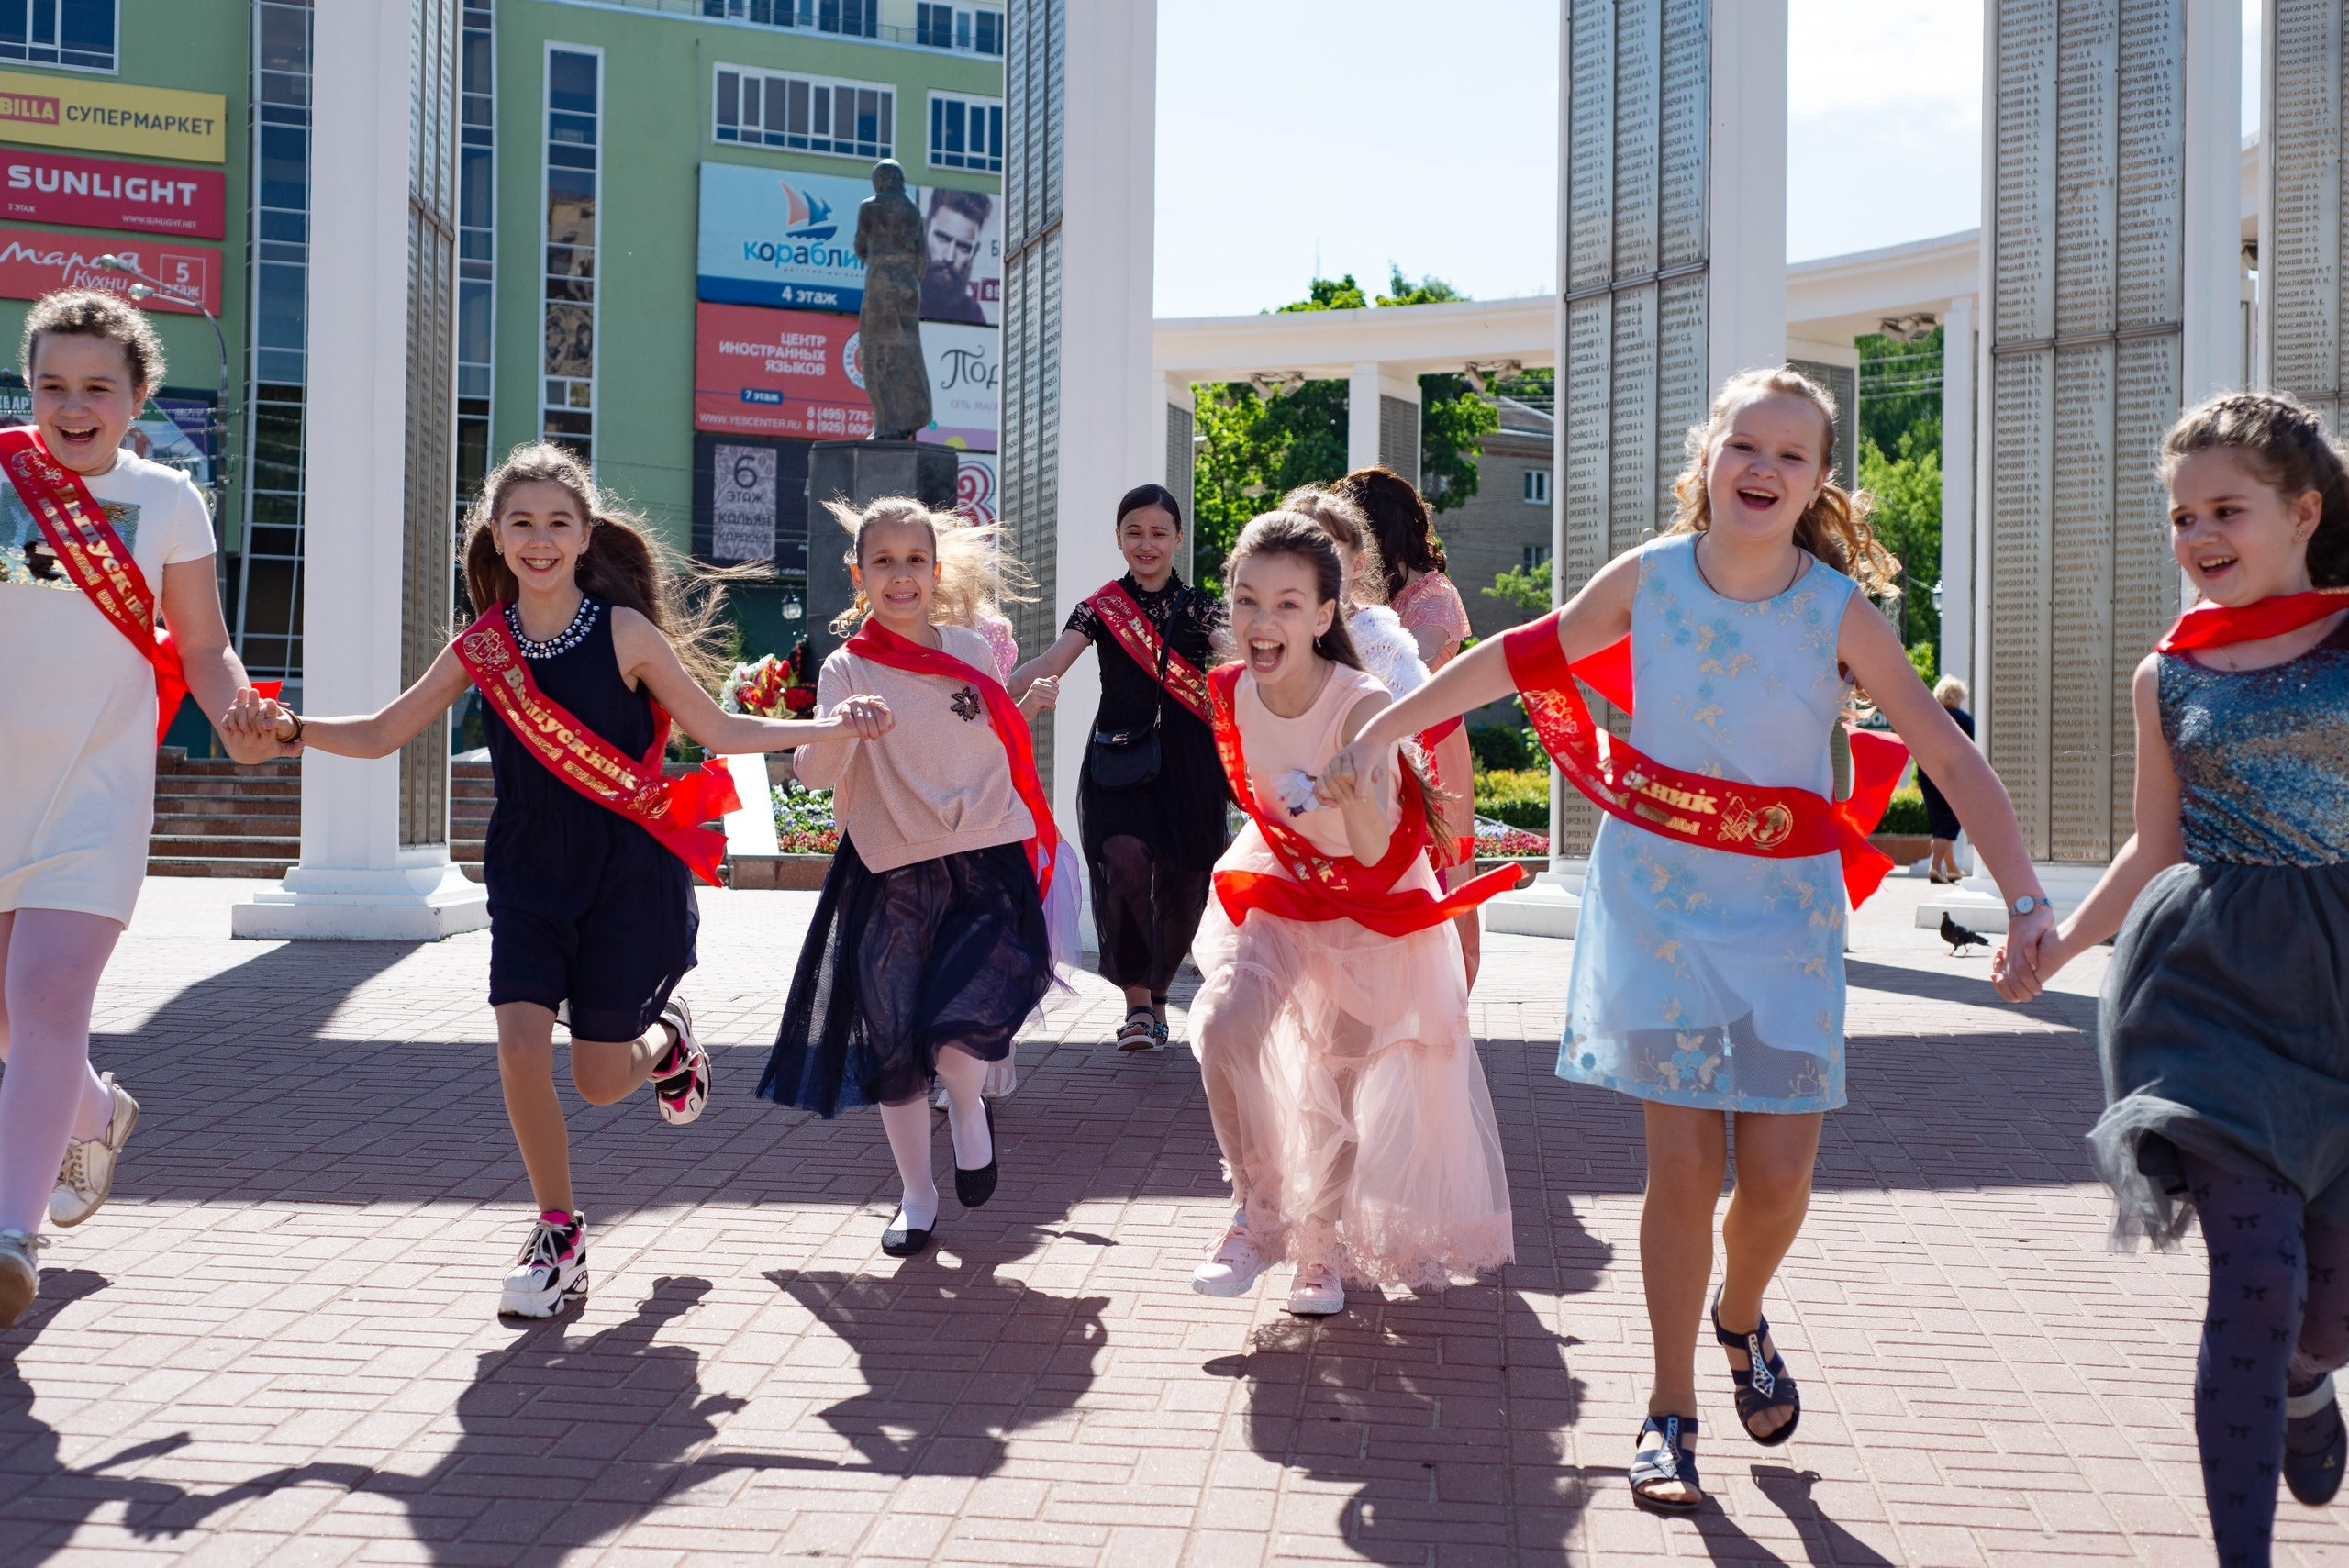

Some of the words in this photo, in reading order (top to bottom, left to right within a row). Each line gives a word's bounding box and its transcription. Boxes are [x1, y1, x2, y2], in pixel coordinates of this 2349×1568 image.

[2280, 3, 2311, 15] МАКАРОВ
[2280, 14, 2312, 25] МАКАРОВ
[2280, 24, 2311, 35] МАКАРОВ
[2121, 38, 2153, 50] МОНАХОВ
[2279, 35, 2311, 46] МАКАРОВ
[2121, 50, 2148, 61] МОНТИН
[2279, 55, 2311, 67] МАКАРОВ
[2121, 85, 2155, 99] МОРГУНОВ
[0, 97, 55, 120] BILLA
[2121, 98, 2155, 110] МОРГУНОВ
[66, 106, 215, 136] СУПЕРМАРКЕТ
[7, 165, 198, 206] SUNLIGHT
[15, 204, 36, 213] ЭТАЖ
[2120, 245, 2150, 255] МОРОЗОВ
[176, 262, 190, 283] 5
[72, 269, 128, 291] Кухни
[2277, 278, 2313, 288] МАКЛАКОВ
[781, 285, 794, 303] 4
[796, 289, 838, 306] этаж
[2277, 290, 2300, 298] МАКОВ
[2277, 320, 2312, 329] МАКСАКОВ
[781, 332, 826, 347] ЦЕНТР
[719, 340, 826, 361] ИНОСТРАННЫХ
[2277, 352, 2313, 361] МАКСИМОВ
[765, 360, 826, 376] ЯЗЫКОВ
[744, 390, 751, 400] 7
[751, 391, 779, 403] этаж
[807, 407, 814, 418] 8
[807, 420, 814, 431] 8
[817, 421, 845, 435] (925)
[1998, 425, 2026, 435] МОРОЗОВ
[1570, 457, 1586, 466] ОРЕХОВ
[1997, 461, 2025, 470] МОРОЗОВ
[734, 455, 757, 488] 6
[1570, 469, 1586, 479] ОРЕХОВ
[727, 490, 763, 503] ЭТАЖ
[718, 512, 772, 526] КАЛЬЯН
[1995, 696, 2022, 705] МОРОЗОВ
[502, 663, 639, 792] Выпускник
[492, 683, 565, 762] начальной
[562, 760, 620, 802] школы
